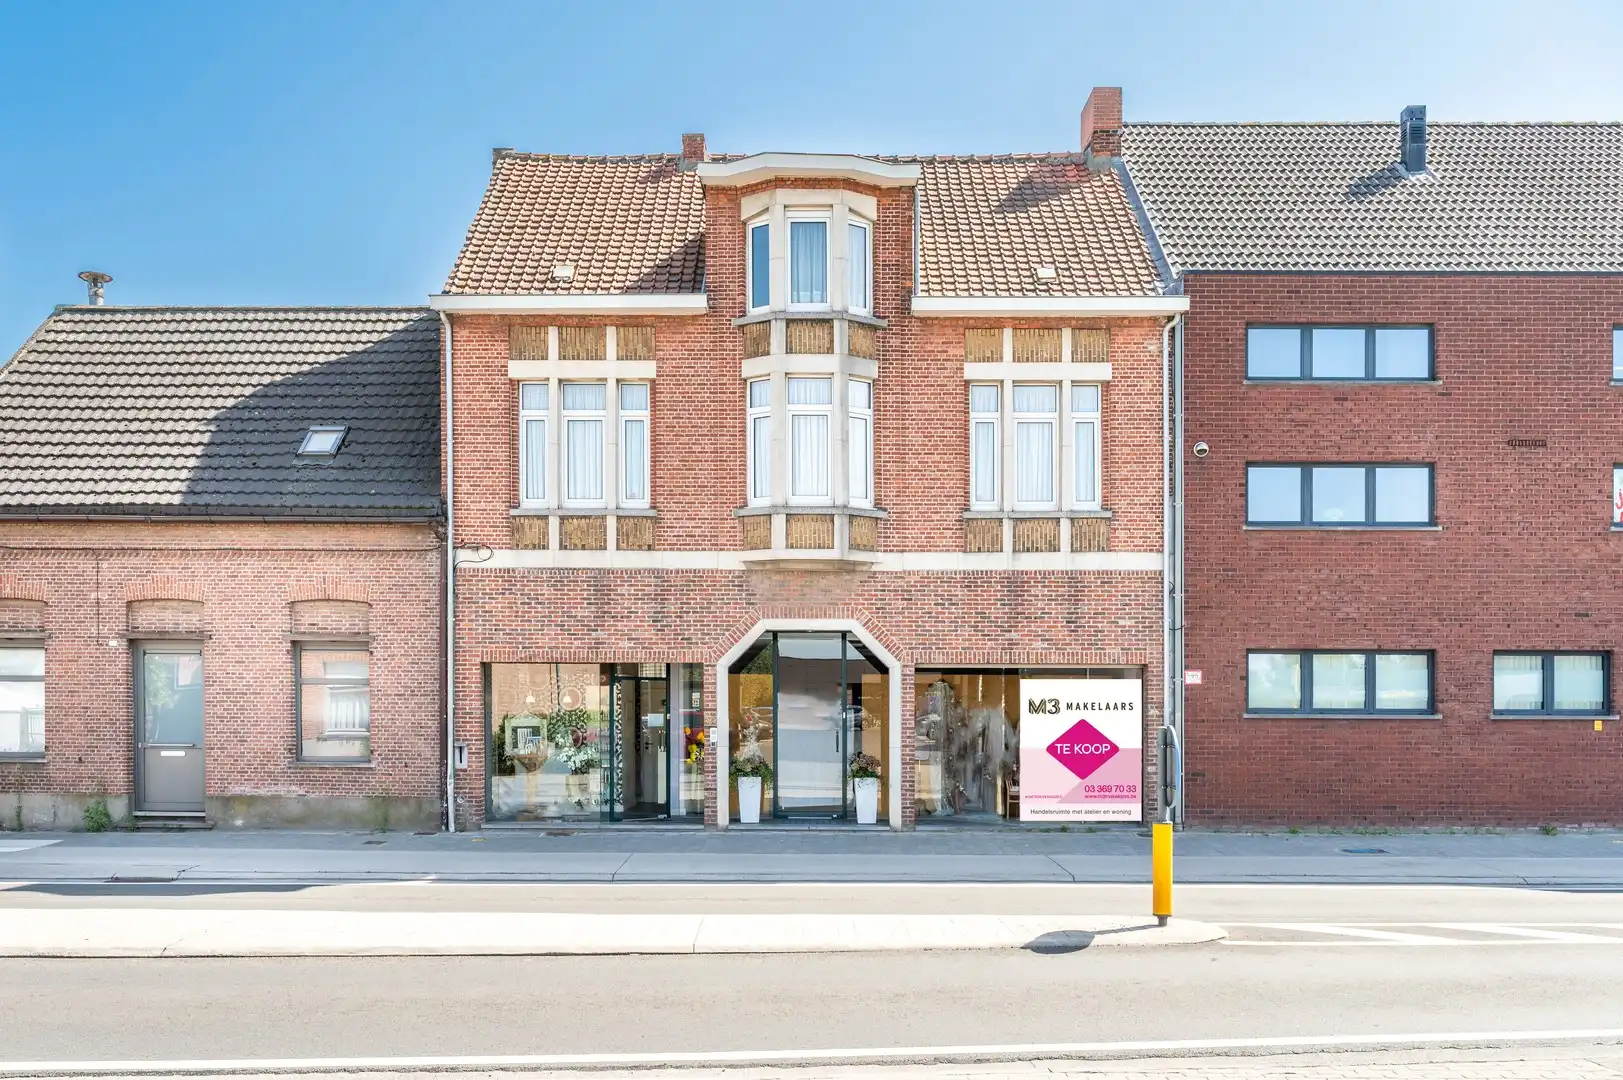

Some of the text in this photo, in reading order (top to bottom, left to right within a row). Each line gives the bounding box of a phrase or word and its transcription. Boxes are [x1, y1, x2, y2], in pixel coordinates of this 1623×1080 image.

[1028, 698, 1134, 715] M3 MAKELAARS
[1055, 743, 1111, 755] TE KOOP
[1084, 784, 1137, 793] 03 369 70 33
[1111, 808, 1132, 816] woning
